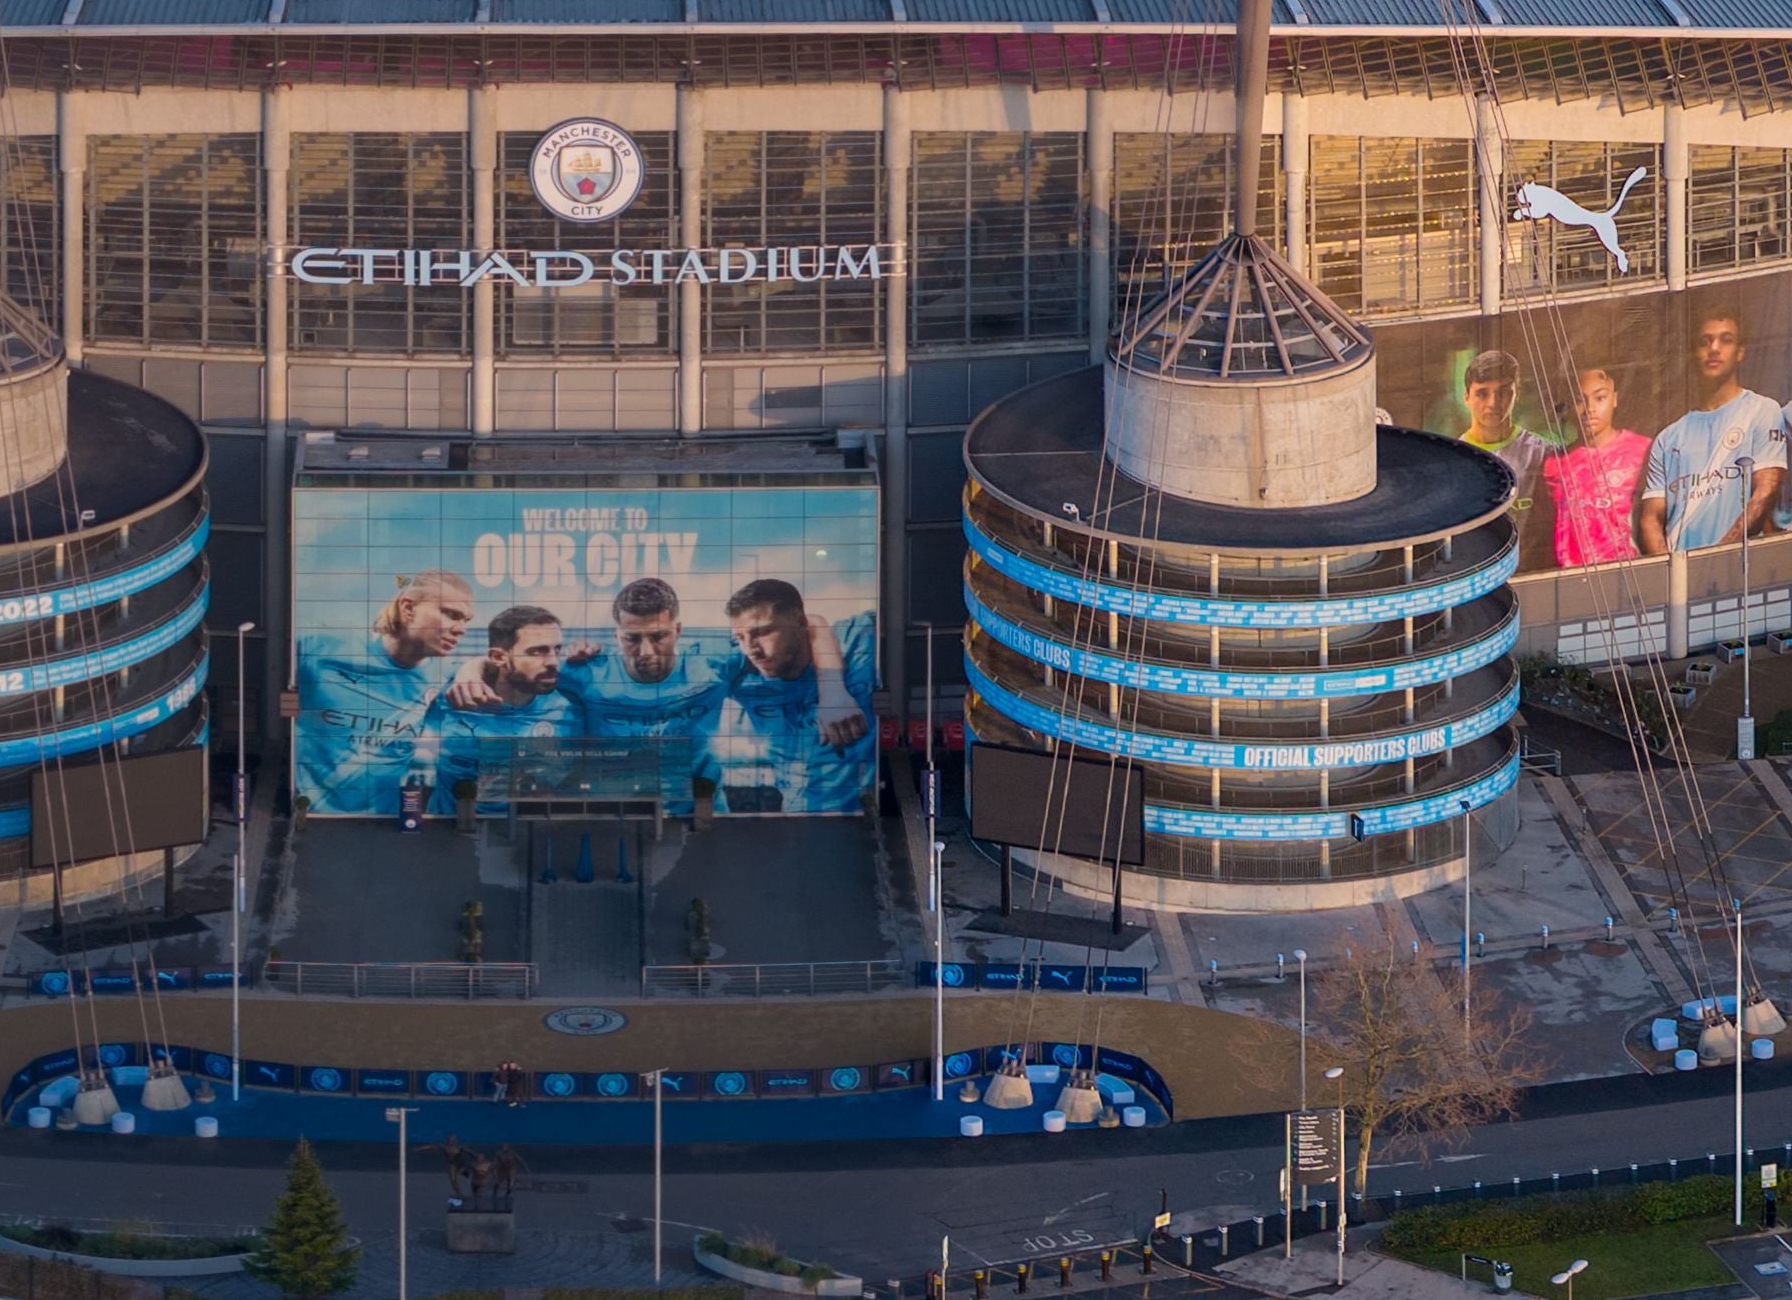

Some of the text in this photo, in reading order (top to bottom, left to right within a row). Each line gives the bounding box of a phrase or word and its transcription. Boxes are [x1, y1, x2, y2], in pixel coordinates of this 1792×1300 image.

[541, 126, 632, 162] MANCHESTER
[570, 205, 604, 218] CITY
[291, 244, 882, 288] ETIHAD STADIUM
[1669, 466, 1743, 493] ETIHAD
[521, 507, 648, 534] WELCOME TO
[473, 533, 698, 588] OUR CITY
[1033, 634, 1071, 668] CLUBS
[1245, 745, 1311, 768] OFFICIAL
[1314, 736, 1405, 765] SUPPORTERS
[1408, 729, 1446, 756] CLUBS
[1023, 1229, 1094, 1252] STOP
